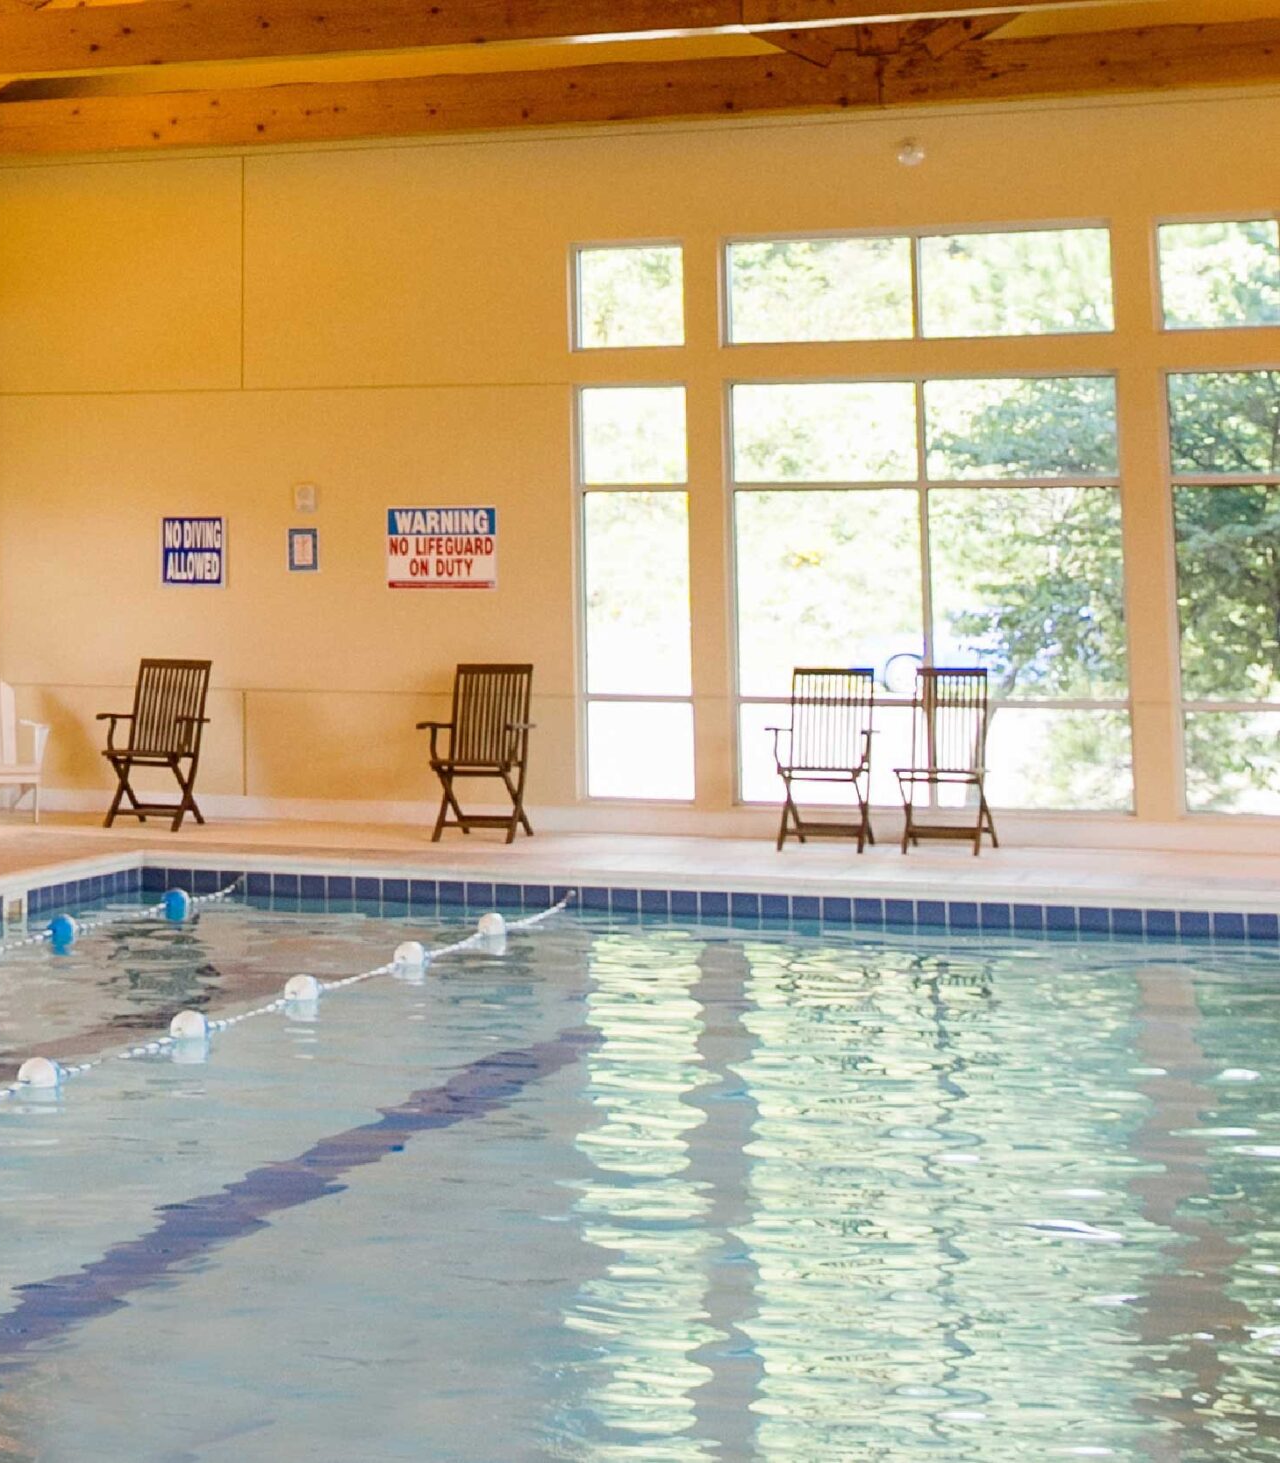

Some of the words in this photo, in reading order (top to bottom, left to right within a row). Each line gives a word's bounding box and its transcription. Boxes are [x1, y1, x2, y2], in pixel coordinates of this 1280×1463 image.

[165, 520, 182, 548] NO
[183, 520, 221, 548] DIVING
[394, 510, 489, 534] WARNING
[389, 537, 409, 556] NO
[415, 537, 493, 556] LIFEGUARD
[166, 551, 220, 580] ALLOWED
[409, 558, 429, 576] ON
[436, 558, 474, 576] DUTY
